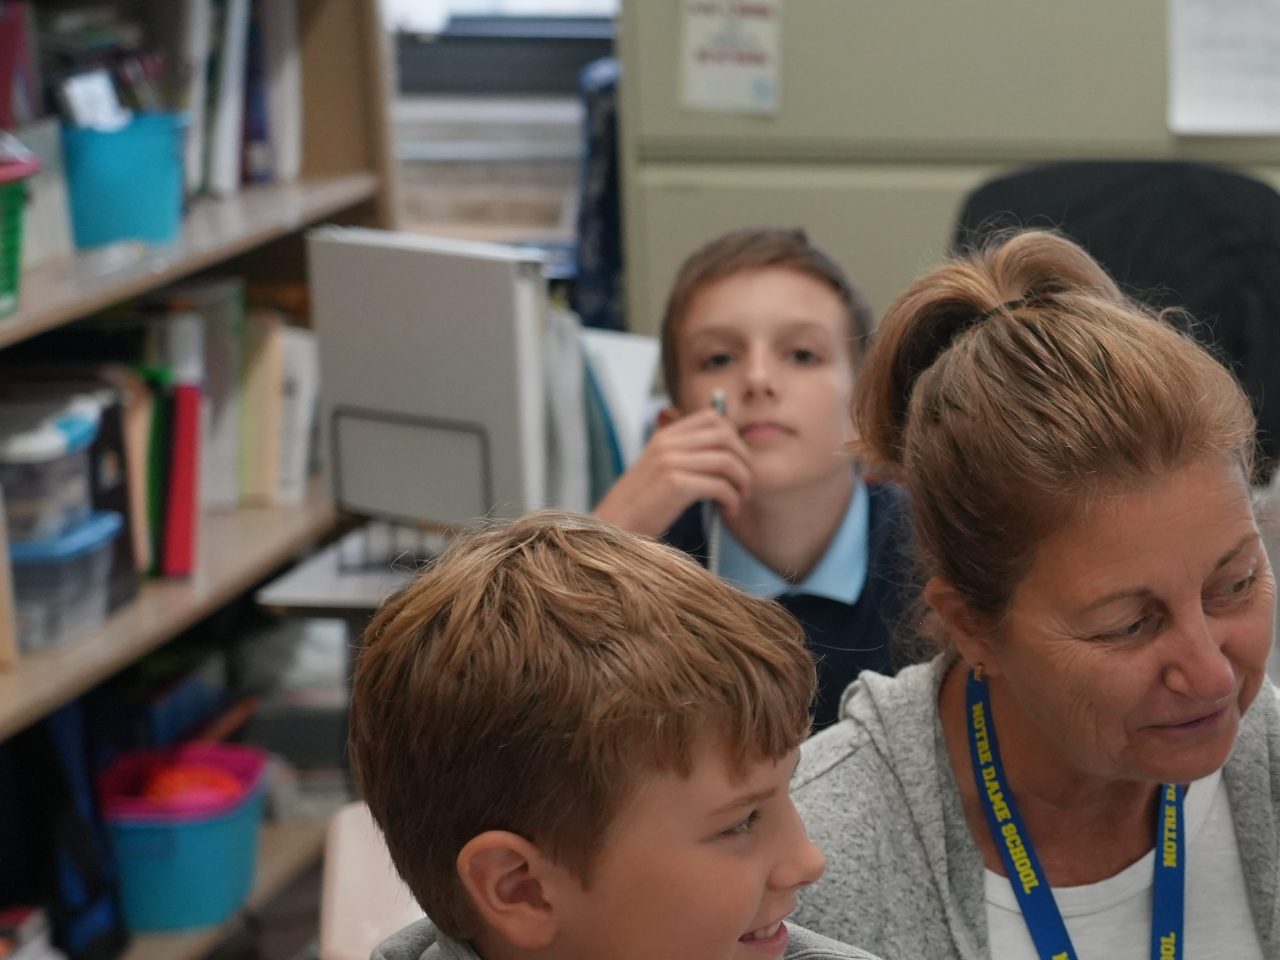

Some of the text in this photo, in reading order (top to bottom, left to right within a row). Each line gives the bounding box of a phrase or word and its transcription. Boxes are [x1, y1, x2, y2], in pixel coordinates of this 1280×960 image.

[972, 701, 1040, 894] NOTRE DAME SCHOOL
[1163, 806, 1177, 867] NOTRE
